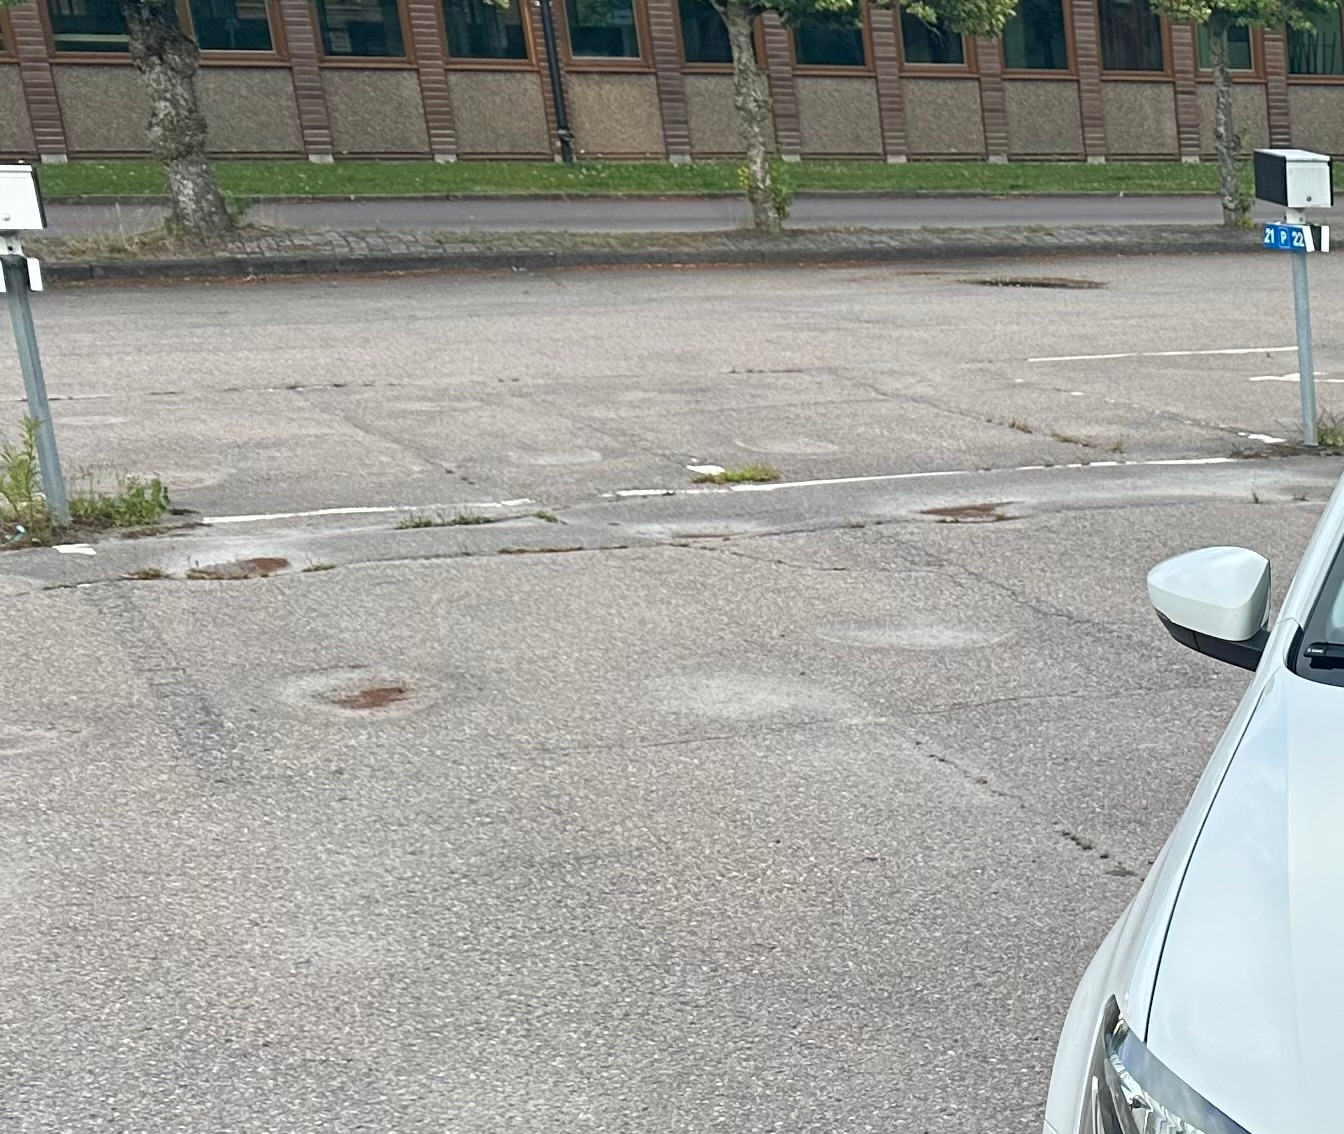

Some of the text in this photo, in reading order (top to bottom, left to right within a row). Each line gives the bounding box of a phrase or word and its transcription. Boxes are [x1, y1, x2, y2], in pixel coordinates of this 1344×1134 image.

[1264, 228, 1305, 247] 21 P 22
